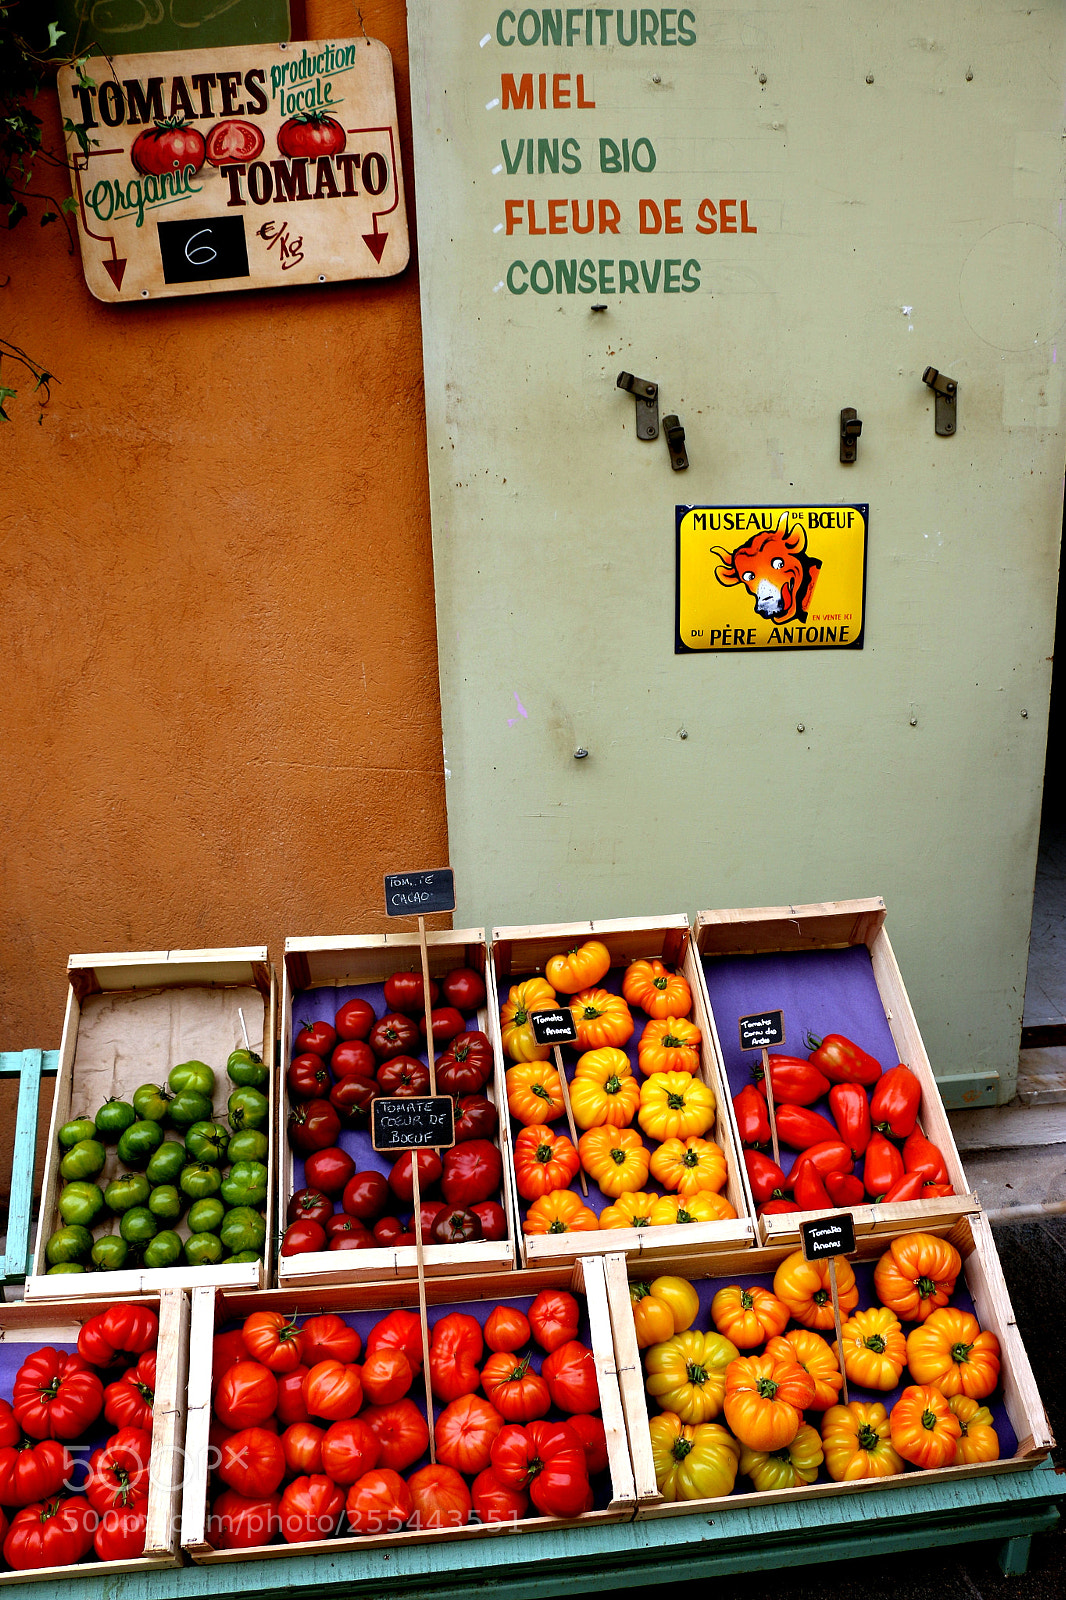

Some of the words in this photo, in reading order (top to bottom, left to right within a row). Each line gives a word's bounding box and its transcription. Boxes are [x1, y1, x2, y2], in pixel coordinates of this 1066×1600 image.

[496, 9, 697, 47] CONFITURES
[270, 44, 356, 100] production
[71, 69, 269, 128] TOMATES
[280, 78, 334, 117] locale
[501, 73, 596, 110] MIEL
[501, 138, 582, 175] VINS
[599, 137, 657, 173] BIO
[84, 160, 203, 228] Organic
[220, 152, 388, 207] TOMATO
[504, 199, 621, 236] FLEUR
[639, 199, 683, 235] DE
[696, 198, 758, 235] SEL
[184, 228, 217, 265] 6
[506, 258, 702, 295] CONSERVES
[693, 512, 773, 531] MUSEAU
[791, 512, 804, 520] DE
[691, 629, 704, 637] DU
[767, 626, 850, 644] ANTOINE
[391, 891, 430, 906] CACAO
[379, 1101, 434, 1113] TOMATE
